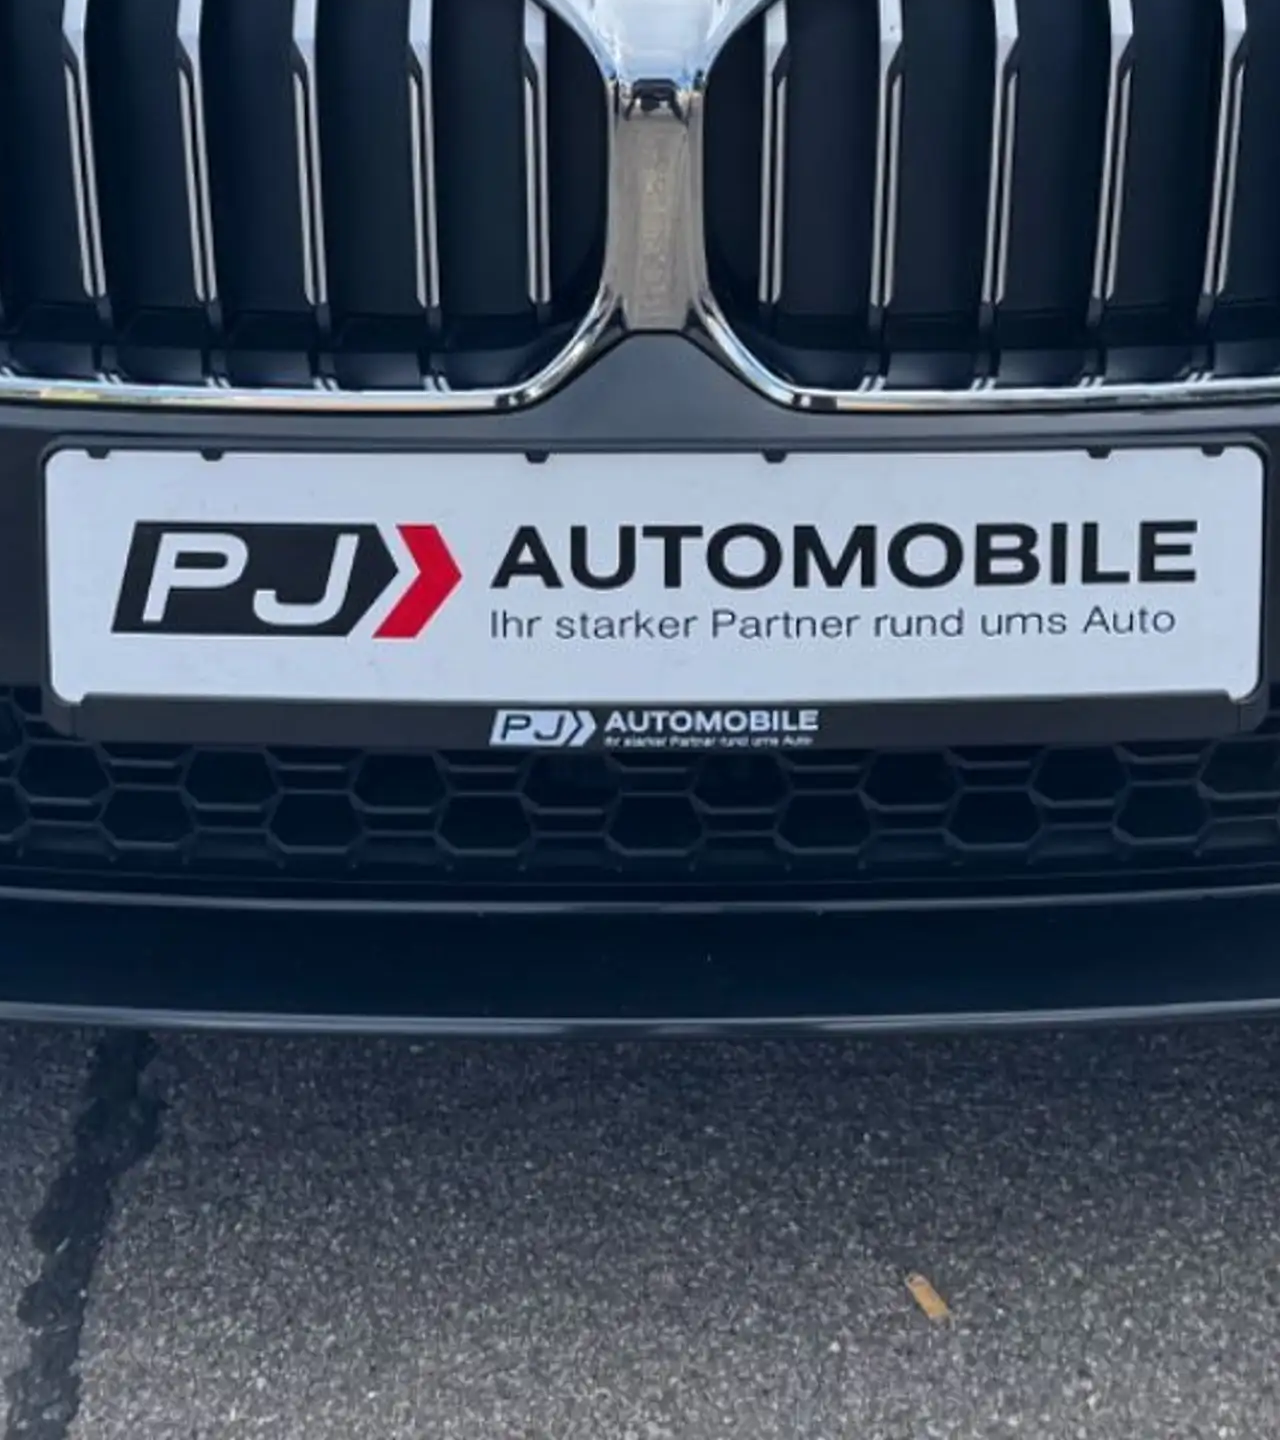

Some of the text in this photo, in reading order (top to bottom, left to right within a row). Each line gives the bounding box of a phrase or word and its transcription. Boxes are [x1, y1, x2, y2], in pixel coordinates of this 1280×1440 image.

[142, 521, 1197, 626] PJ AUTOMOBILE
[490, 606, 1176, 639] Ihr starker Partner rund ums Auto
[500, 710, 819, 741] PJ AUTOMOBILE
